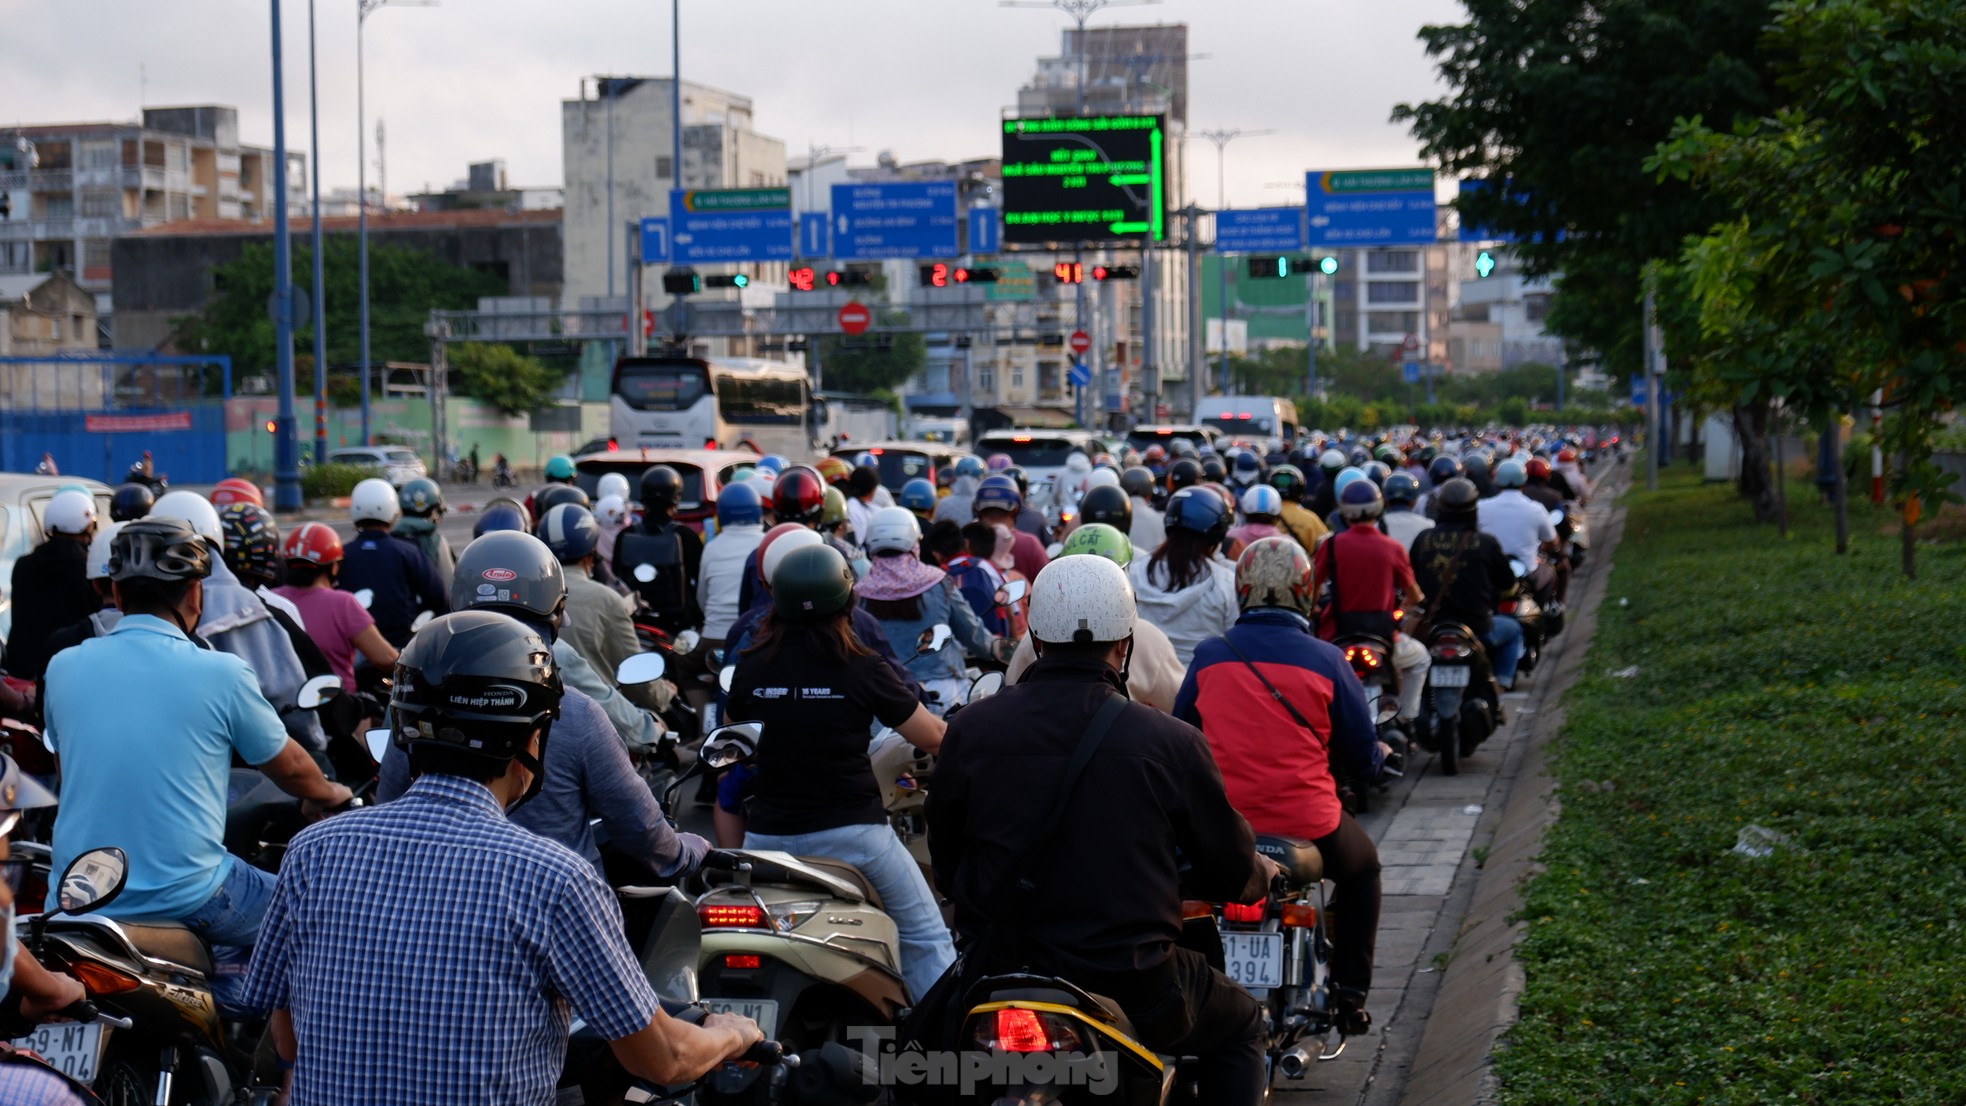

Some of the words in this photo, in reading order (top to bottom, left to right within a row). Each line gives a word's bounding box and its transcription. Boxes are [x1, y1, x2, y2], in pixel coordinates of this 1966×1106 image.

[788, 267, 814, 291] 42
[1055, 262, 1082, 284] 41
[450, 695, 469, 705] LIÊN
[1255, 844, 1285, 855] NDA
[1231, 960, 1270, 984] 394
